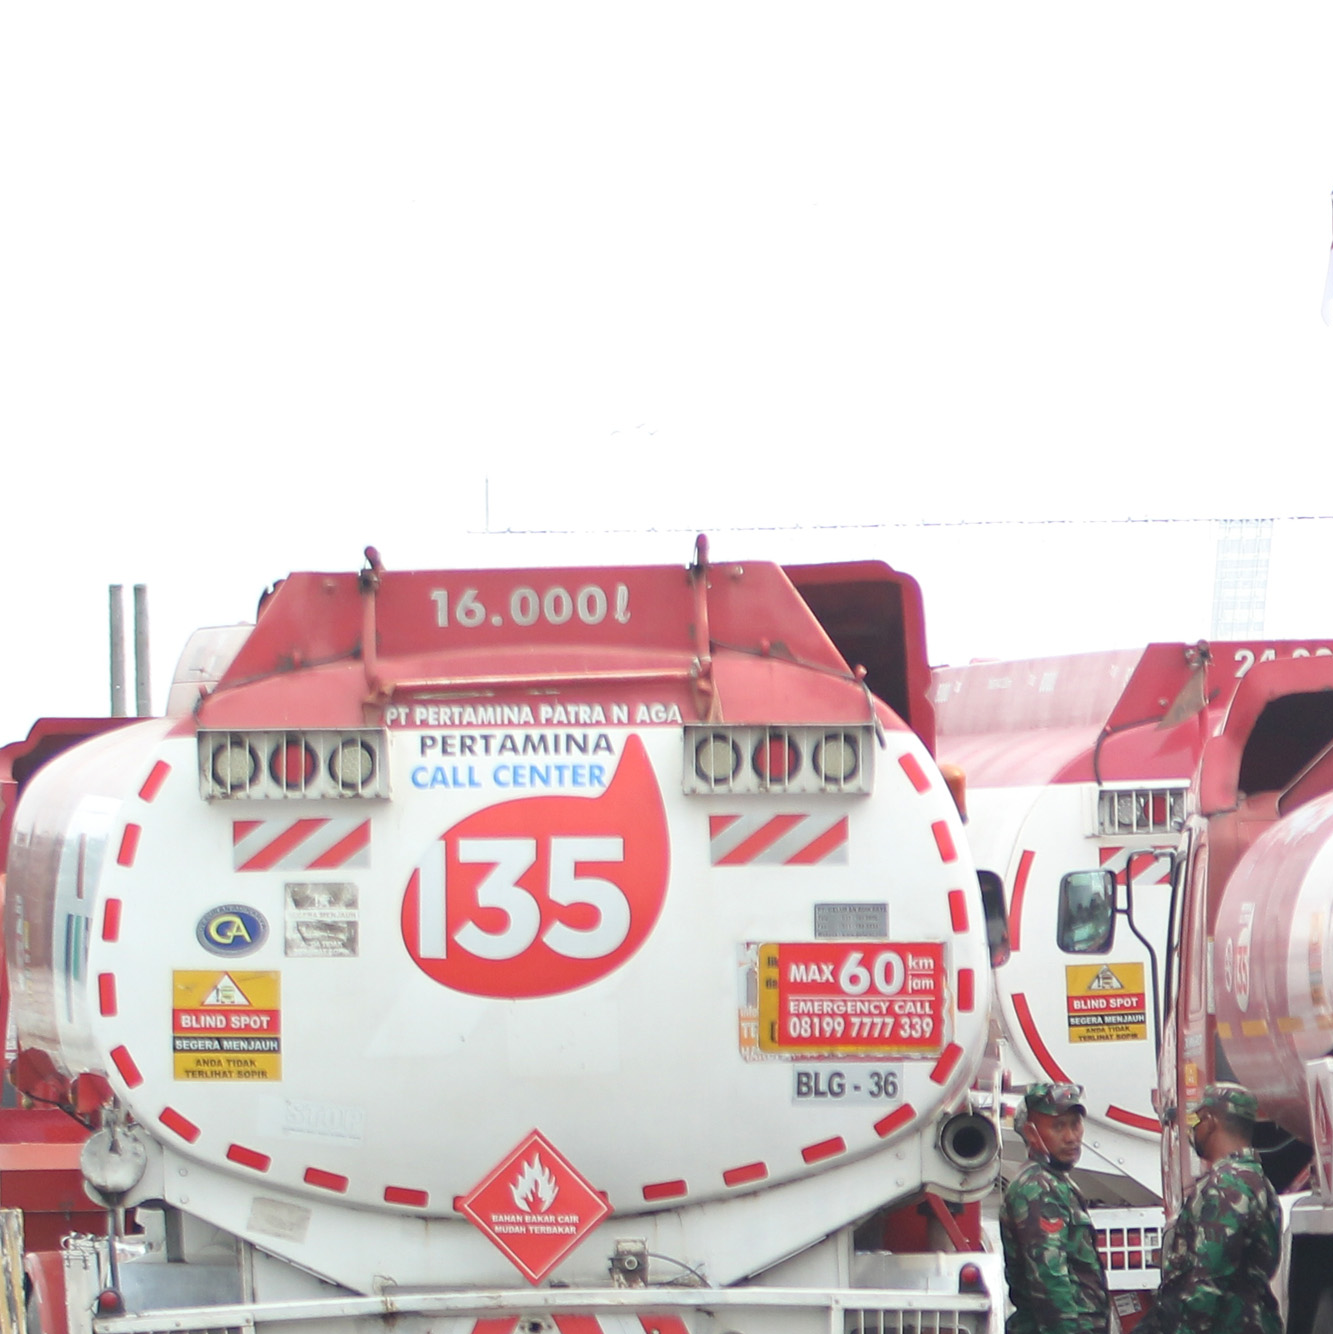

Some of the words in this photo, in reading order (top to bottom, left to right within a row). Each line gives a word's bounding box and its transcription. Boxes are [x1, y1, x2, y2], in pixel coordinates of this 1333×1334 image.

[415, 703, 535, 726] PERTAMINA
[541, 703, 606, 725] PATRA
[420, 733, 616, 758] PERTAMINA
[411, 765, 482, 790] CALL
[493, 764, 607, 789] CENTER
[419, 836, 632, 961] 135
[908, 952, 935, 970] km
[789, 963, 835, 984] MAX
[839, 950, 906, 996] 60
[907, 976, 935, 994] jam
[788, 1001, 890, 1015] EMERGENCY
[894, 1001, 934, 1015] CALL
[1073, 999, 1107, 1010] BLIND
[1109, 997, 1139, 1008] SPOT
[181, 1014, 227, 1029] BLIND
[231, 1014, 271, 1029] SPOT
[789, 1016, 845, 1038] 08199
[850, 1016, 895, 1038] 7777
[900, 1016, 934, 1038] 339
[1070, 1016, 1104, 1025] SEGERA
[1104, 1014, 1145, 1024] MENJAUH
[175, 1038, 221, 1051] SEGERA
[223, 1038, 279, 1051] MENJAUH
[195, 1058, 223, 1068] ANDA
[226, 1058, 257, 1068] TIDAK
[185, 1069, 234, 1079] TERLIHAT
[237, 1069, 269, 1079] SOPIR
[796, 1071, 846, 1099] BLG
[868, 1071, 899, 1098] 36
[491, 1213, 523, 1223] BAHAN
[524, 1213, 556, 1224] BAKAR
[557, 1213, 580, 1224] CAIR
[494, 1225, 527, 1235] MUDAH
[529, 1225, 577, 1235] TERBAKAR
